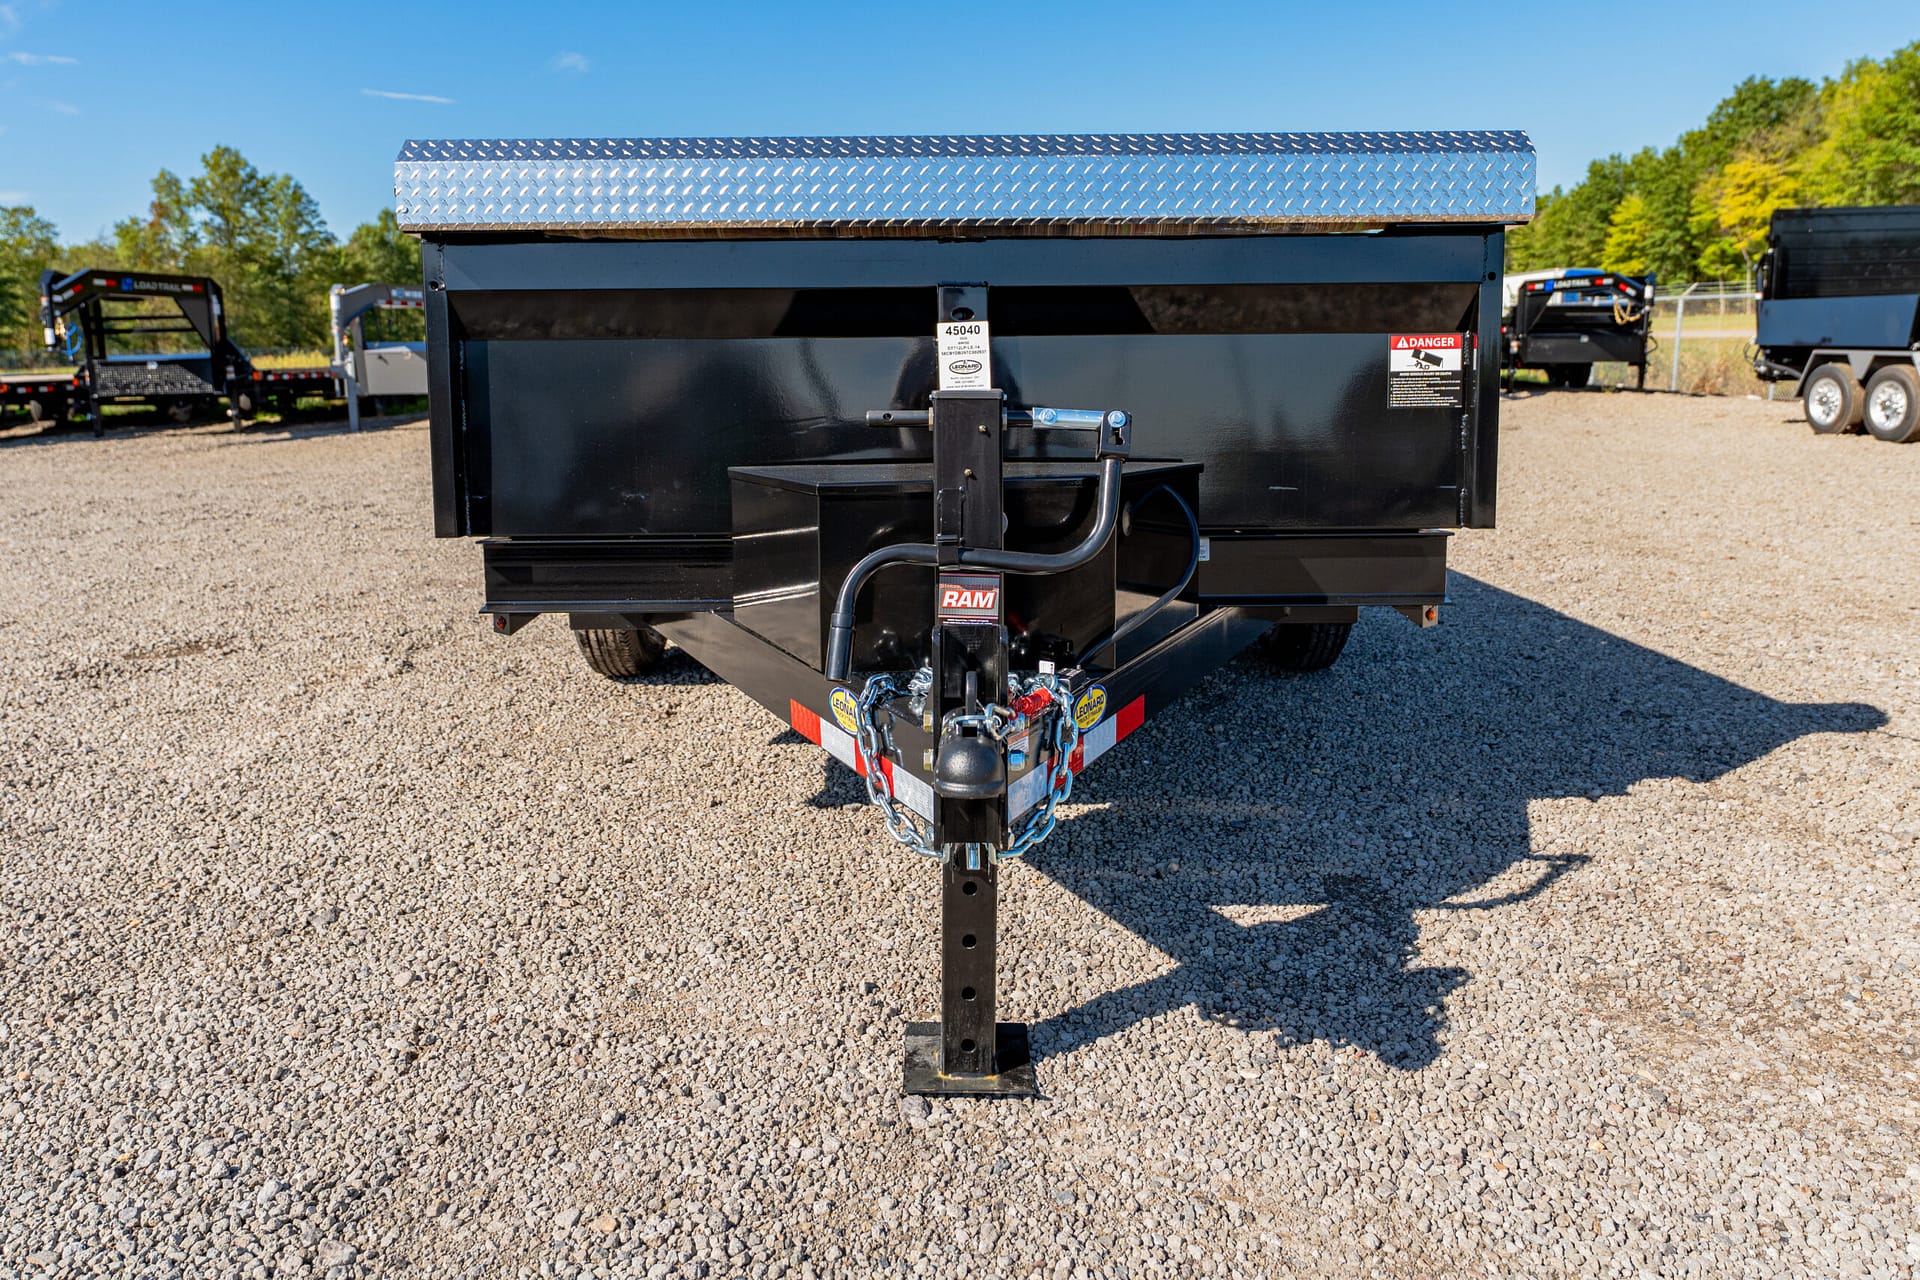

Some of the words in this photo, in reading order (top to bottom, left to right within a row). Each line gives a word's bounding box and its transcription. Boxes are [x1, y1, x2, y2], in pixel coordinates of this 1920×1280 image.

[945, 325, 981, 336] 45040
[1409, 337, 1455, 348] DANGER
[942, 591, 996, 608] RAM
[1075, 694, 1104, 719] LEONARD
